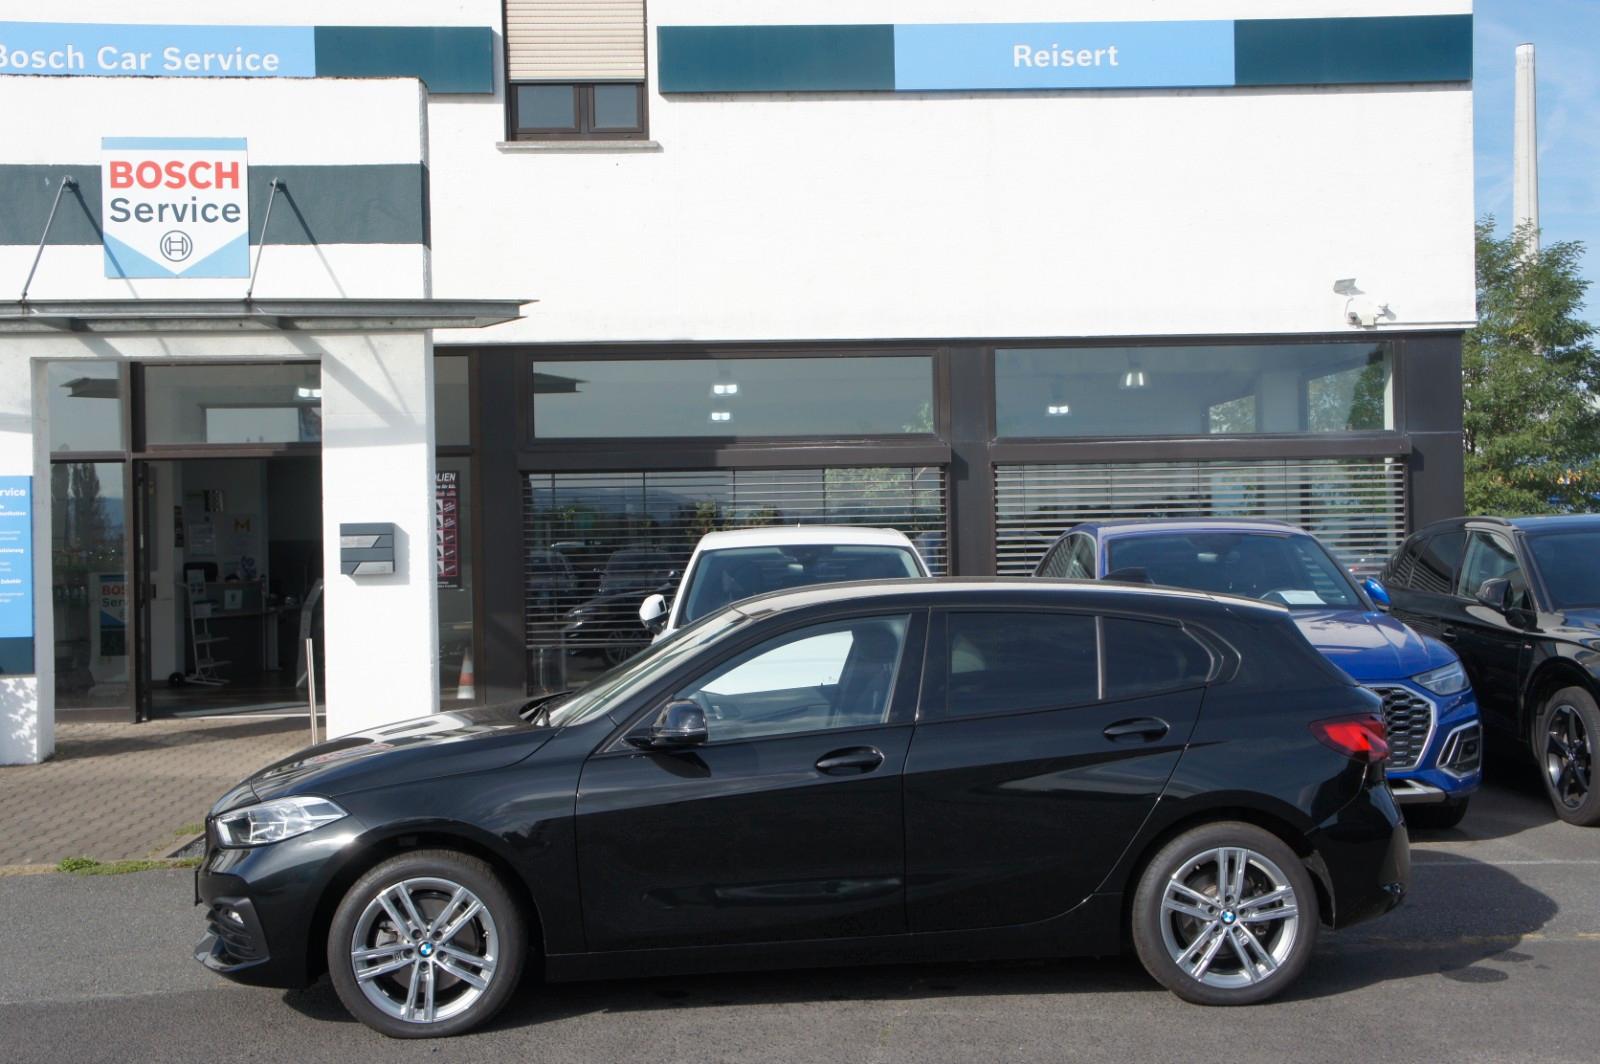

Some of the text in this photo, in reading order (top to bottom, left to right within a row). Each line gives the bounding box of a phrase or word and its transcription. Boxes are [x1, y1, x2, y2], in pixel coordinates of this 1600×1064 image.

[97, 45, 152, 70] Car
[163, 46, 279, 71] Service
[1013, 43, 1119, 67] Reisert
[110, 160, 240, 189] BOSCH
[110, 196, 241, 223] Service
